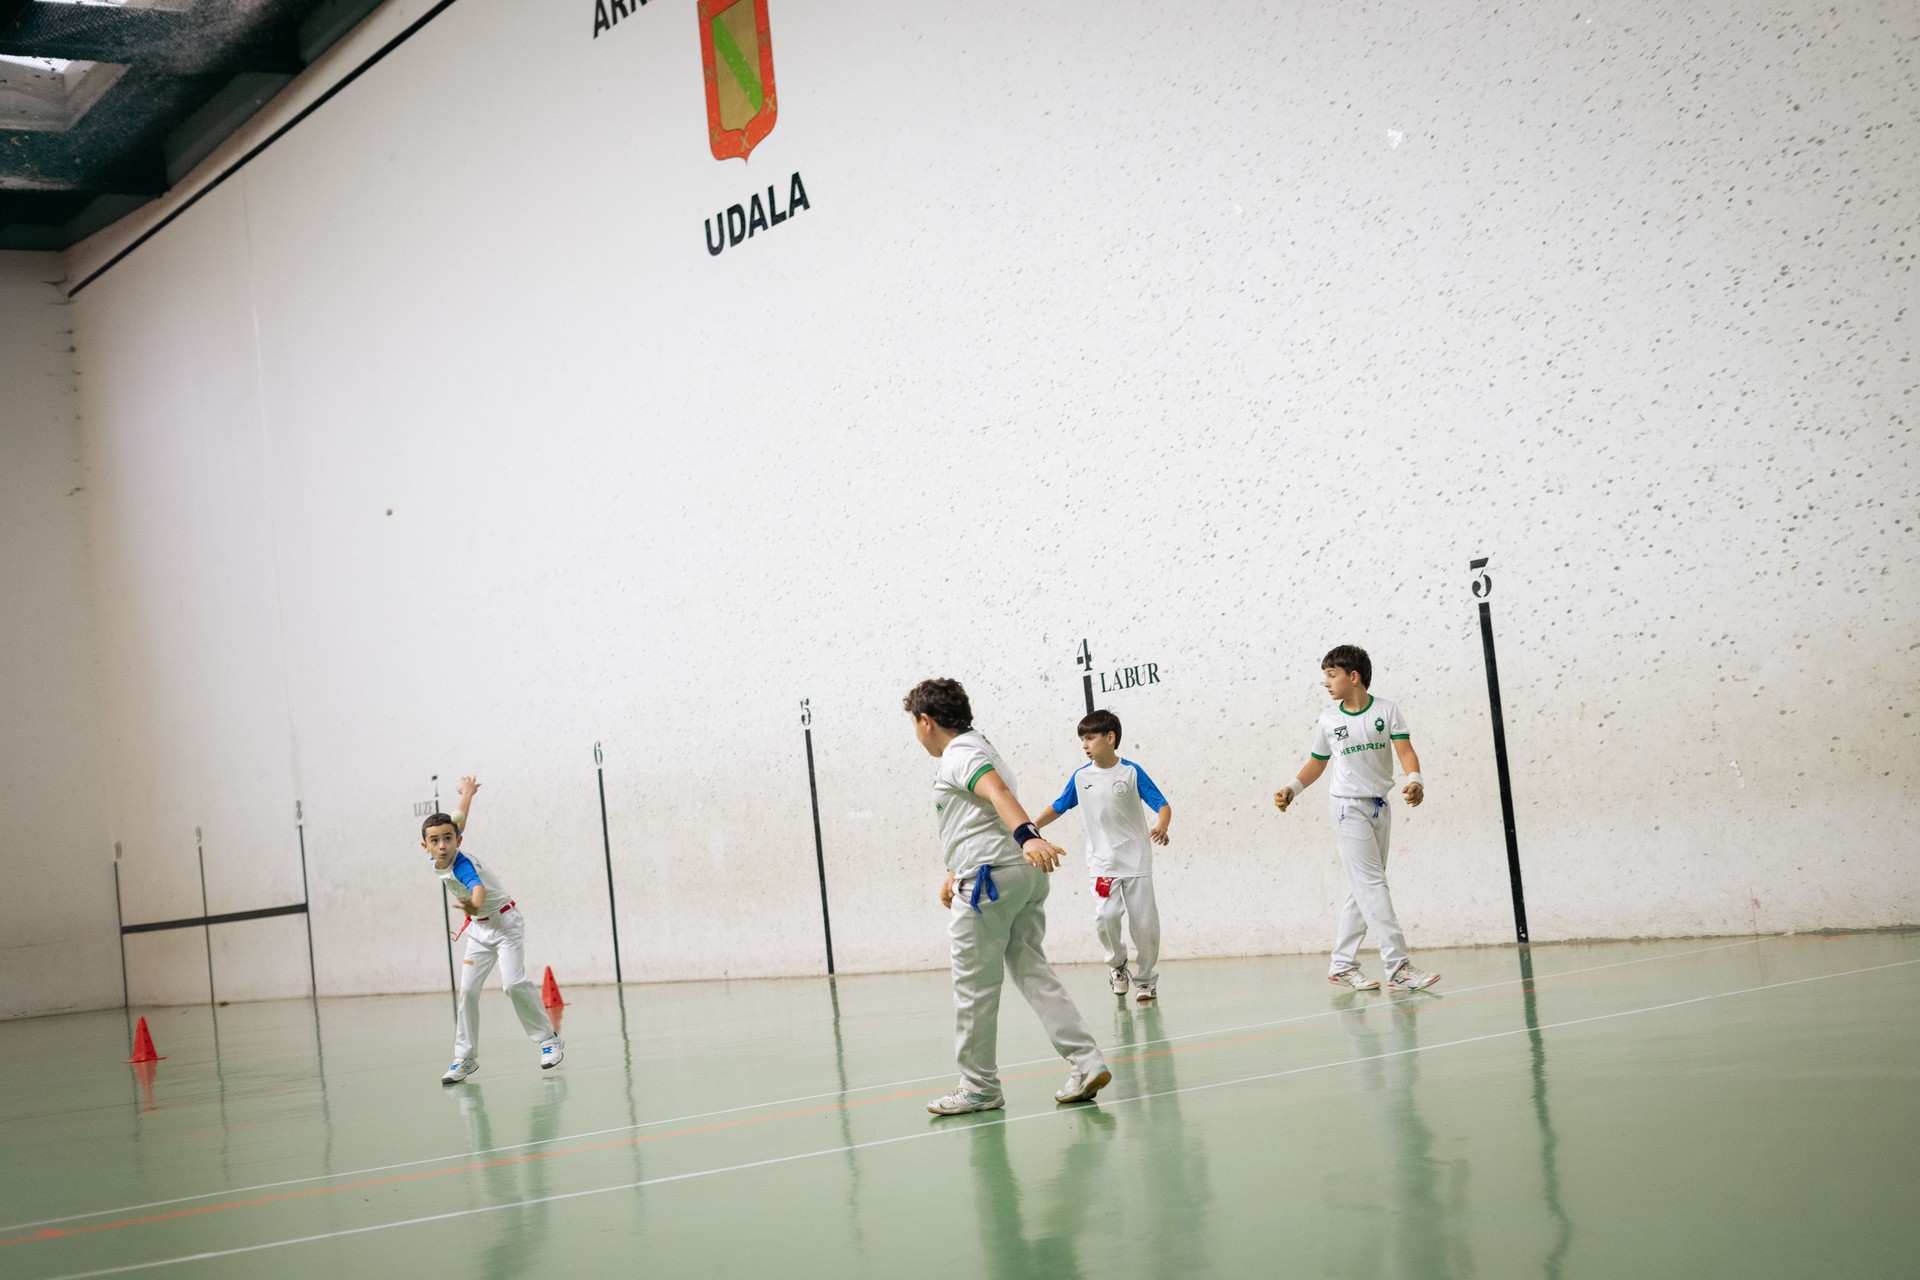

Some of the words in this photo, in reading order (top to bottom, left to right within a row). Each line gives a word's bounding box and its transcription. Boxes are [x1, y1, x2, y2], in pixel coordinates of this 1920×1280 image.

[704, 171, 811, 256] UDALA
[1469, 556, 1492, 598] 3
[1076, 638, 1093, 671] 4
[1099, 662, 1161, 693] LABUR
[800, 697, 811, 726] 5
[593, 740, 603, 765] 6
